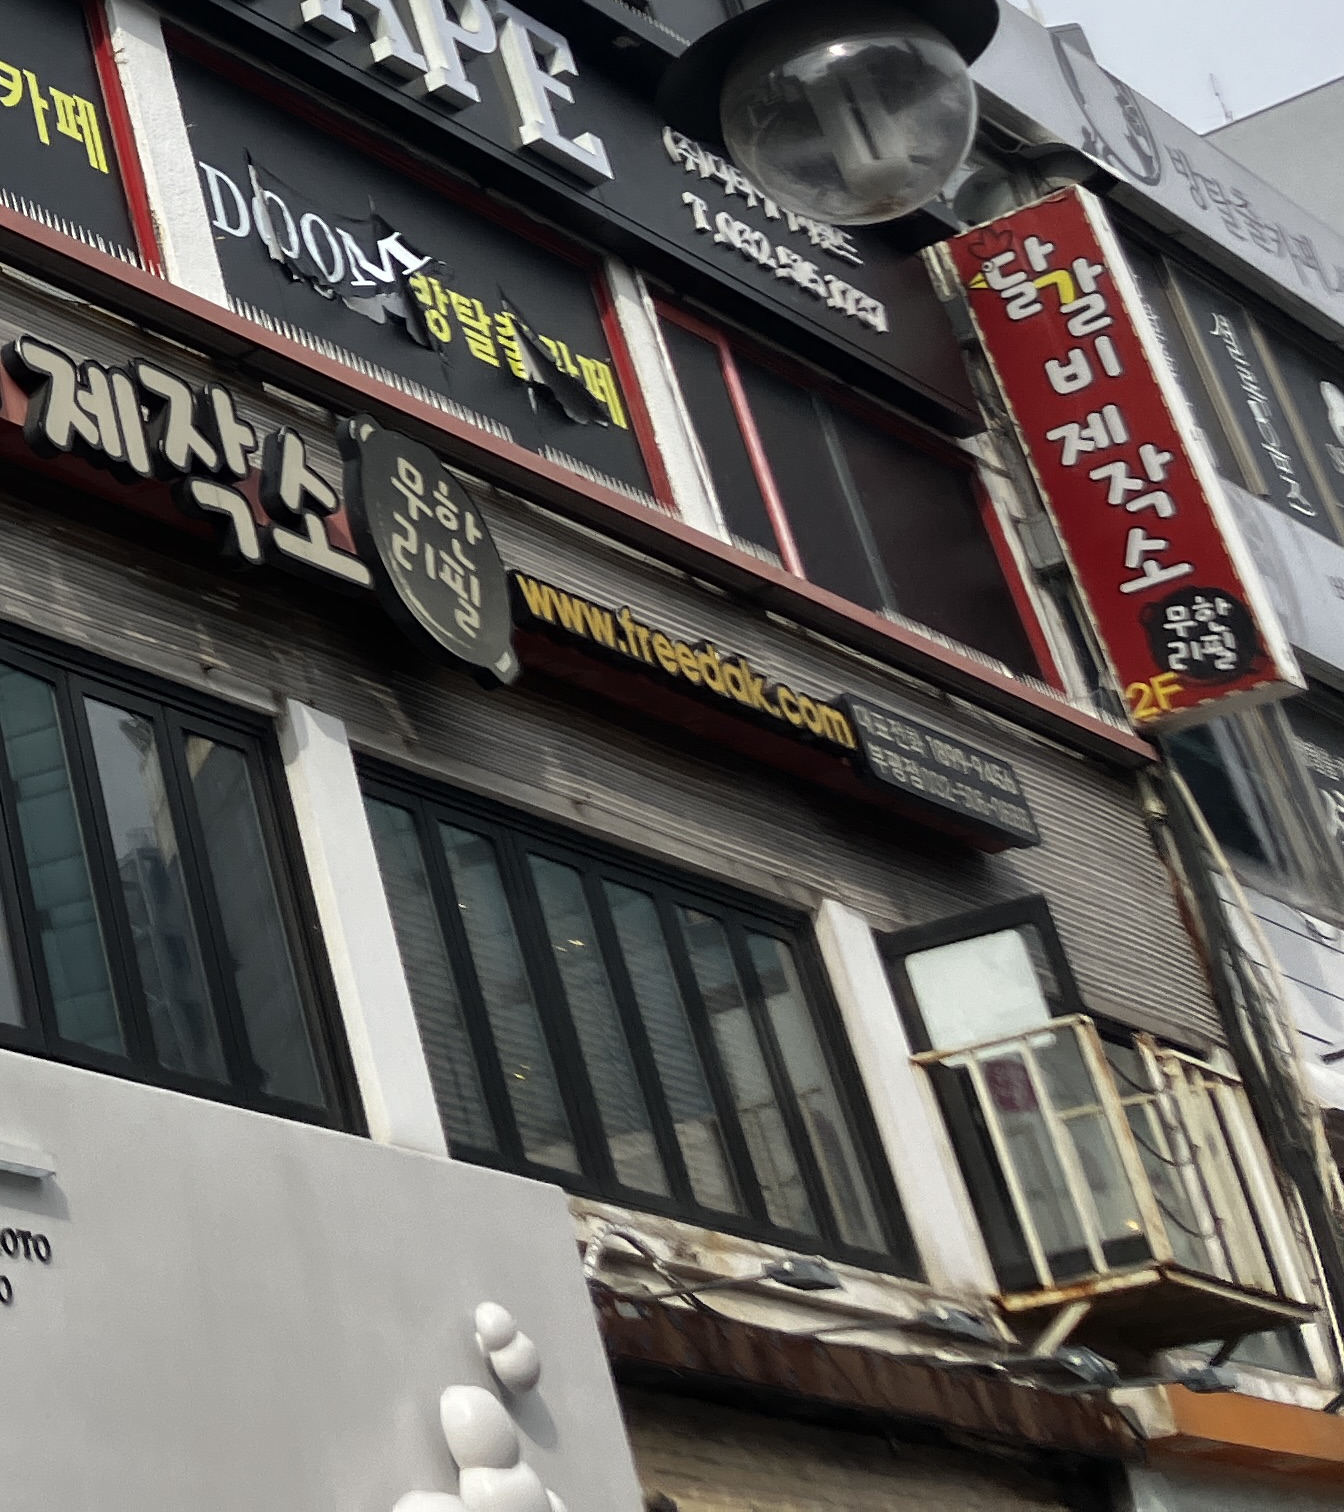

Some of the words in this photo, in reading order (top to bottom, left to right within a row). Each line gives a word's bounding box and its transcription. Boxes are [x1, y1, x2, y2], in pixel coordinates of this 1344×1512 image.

[199, 160, 432, 287] DOOM
[390, 456, 483, 572] 무한
[392, 511, 482, 639] 리필
[1163, 594, 1233, 638] 무한
[515, 573, 858, 750] www.freedak.com
[1125, 672, 1185, 720] 2F
[1167, 631, 1238, 670] 리필
